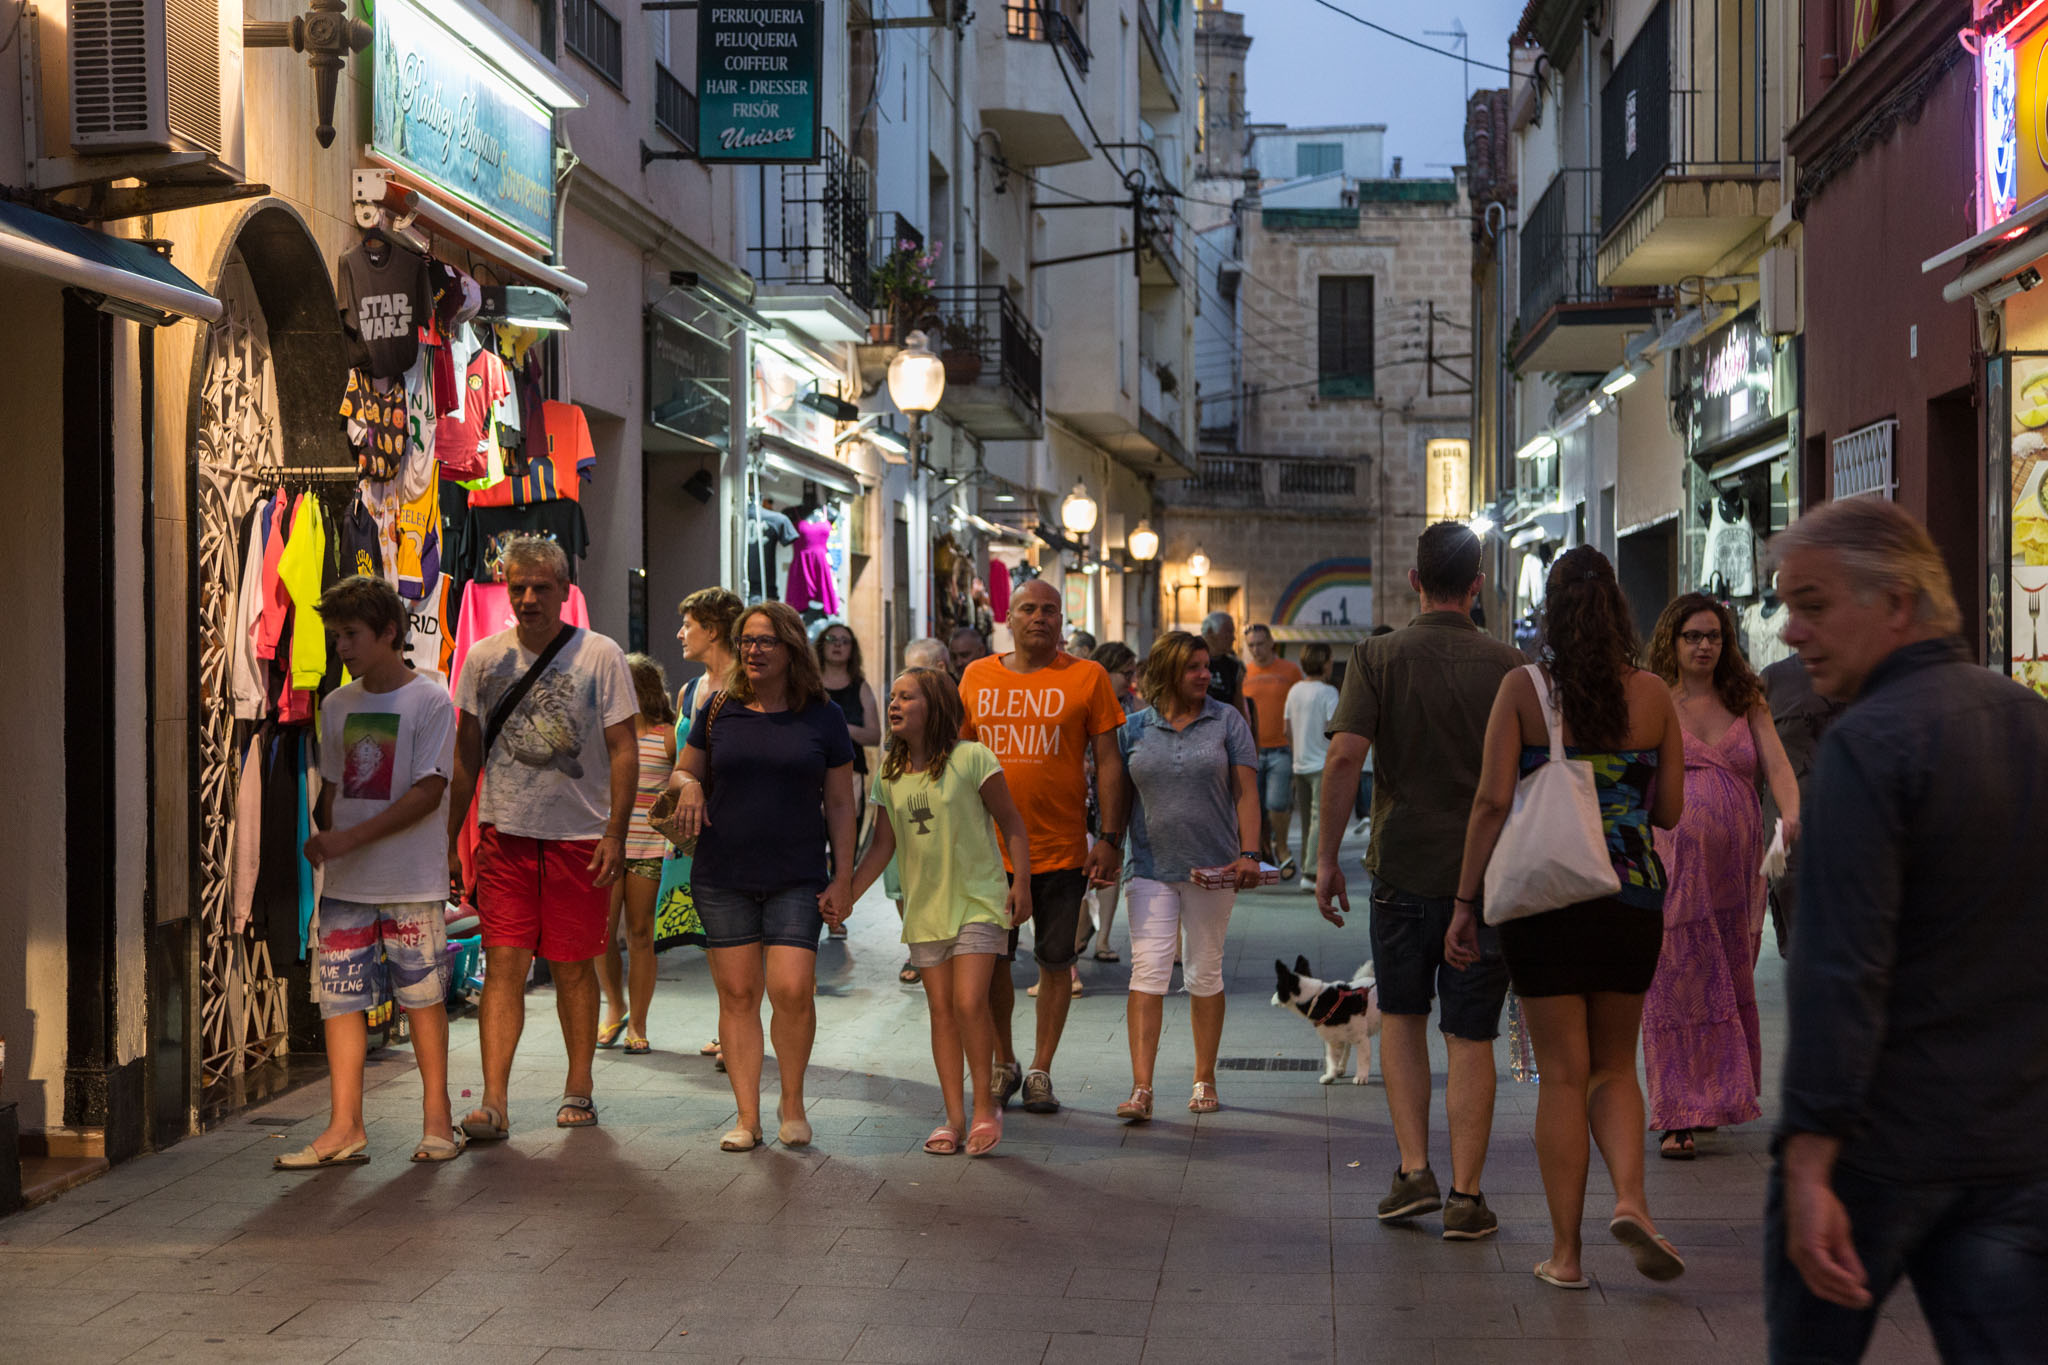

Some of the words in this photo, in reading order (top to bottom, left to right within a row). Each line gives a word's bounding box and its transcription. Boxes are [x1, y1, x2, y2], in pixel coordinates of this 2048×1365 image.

[712, 8, 804, 27] PERRUQUERIA
[716, 32, 798, 50] PELUQUERIA
[724, 56, 788, 71] COIFFEUR
[706, 79, 738, 94] HAIR
[750, 80, 808, 95] DRESSER
[401, 52, 455, 164] Radhey
[458, 91, 500, 182] Shyam
[733, 99, 780, 118] FRISÖR
[719, 127, 797, 149] Unisex
[498, 151, 550, 220] Souvenirs
[359, 293, 413, 319] STAR
[400, 509, 426, 528] GELES
[409, 612, 439, 635] RID
[977, 688, 1065, 718] BLEND
[978, 724, 1060, 755] DENIM
[320, 965, 340, 979] AVE
[348, 963, 363, 977] IS
